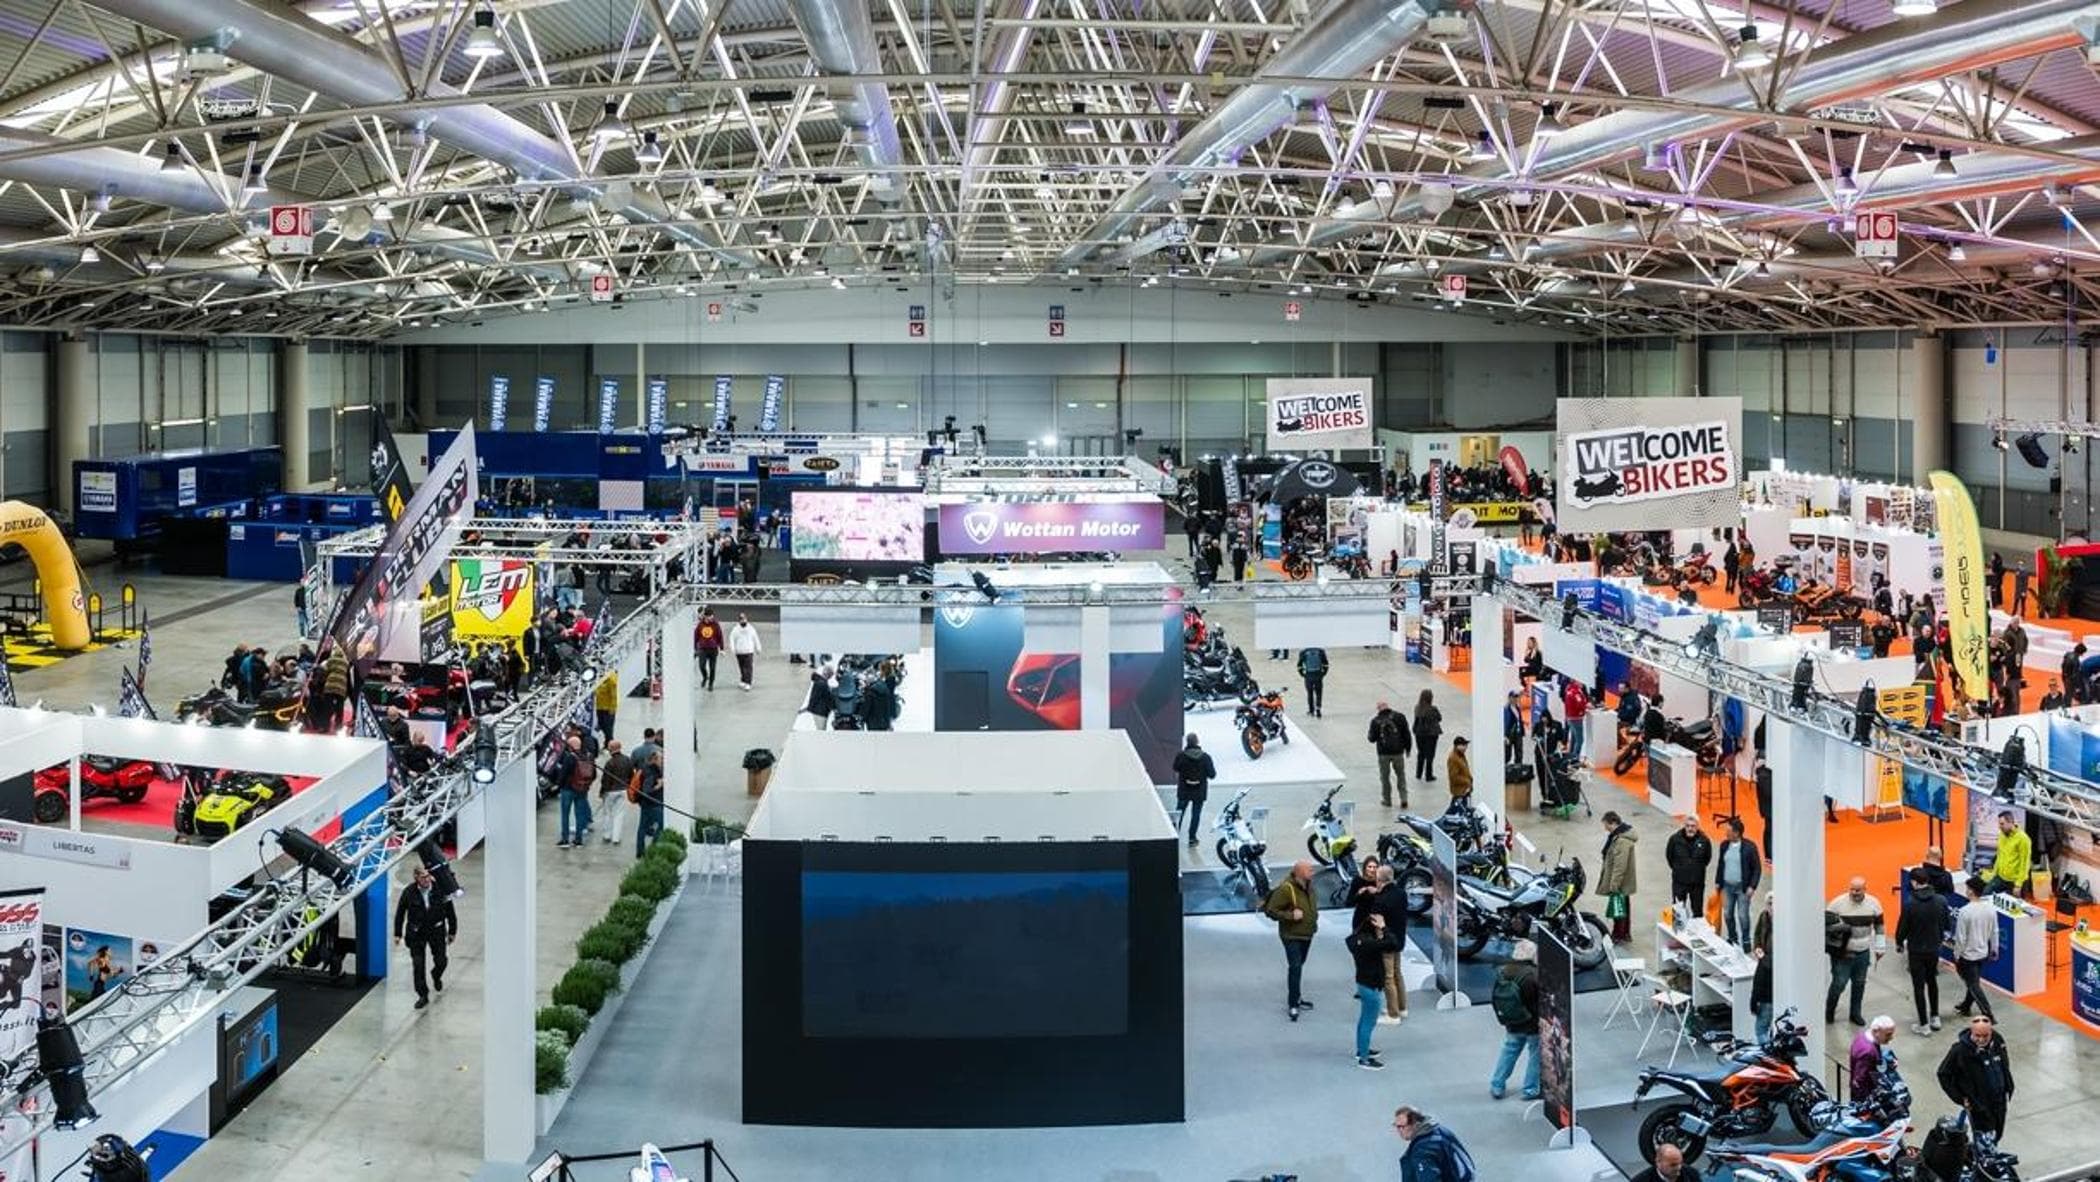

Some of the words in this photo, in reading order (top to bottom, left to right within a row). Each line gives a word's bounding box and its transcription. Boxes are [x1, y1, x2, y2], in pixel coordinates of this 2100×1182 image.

[1279, 394, 1362, 419] WELCOME
[1303, 410, 1364, 430] BIKERS
[1579, 427, 1725, 471] WELCOME
[1623, 457, 1728, 495] BIKERS
[1003, 521, 1075, 537] Wottan
[1081, 521, 1142, 537] Motor
[458, 566, 528, 600] LEM
[52, 841, 96, 855] LIBERTAS
